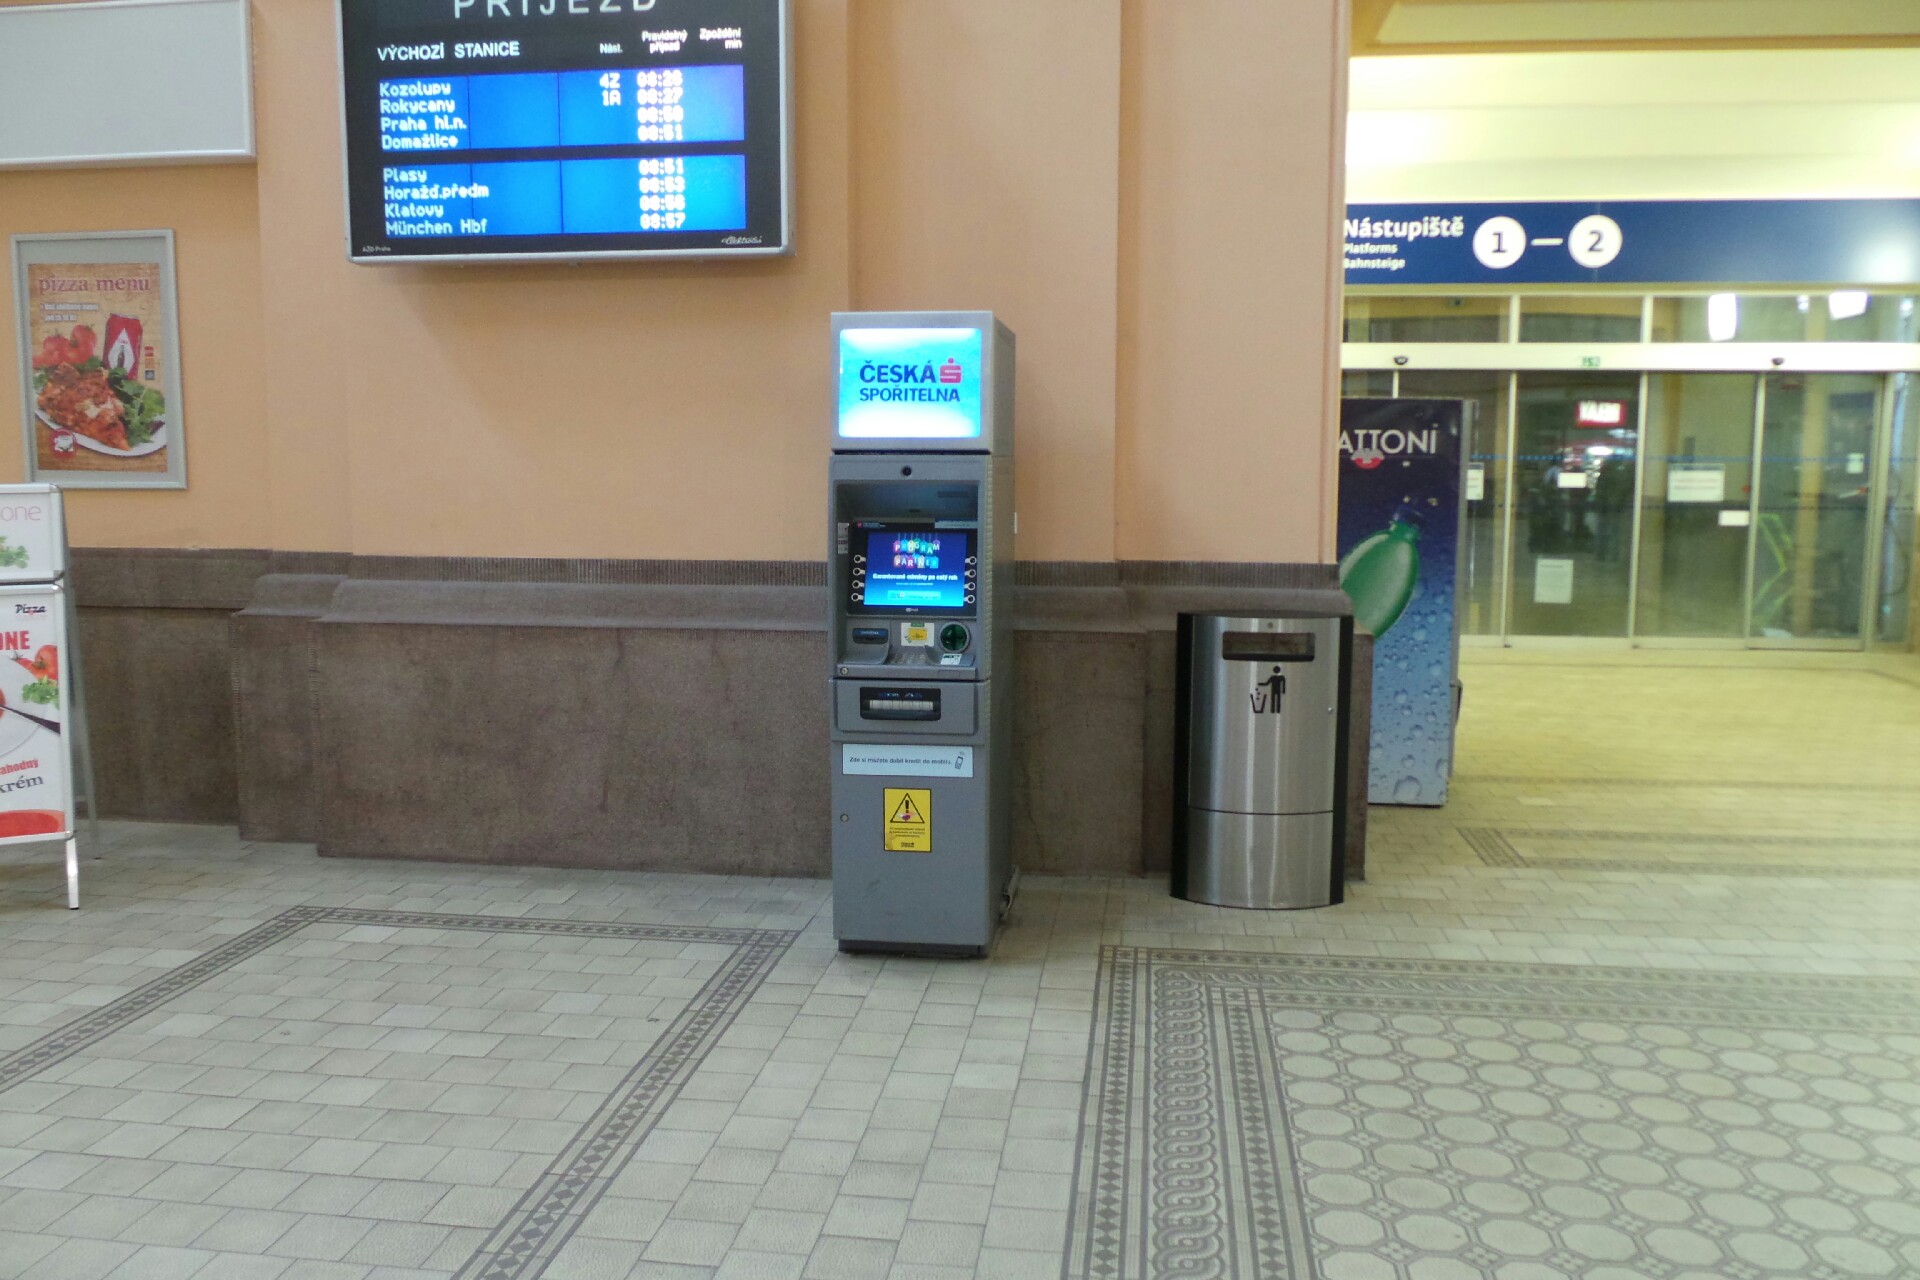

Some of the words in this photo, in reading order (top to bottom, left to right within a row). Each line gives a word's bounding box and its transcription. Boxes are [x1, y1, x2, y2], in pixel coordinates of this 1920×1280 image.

[377, 42, 445, 61] VÝCHOZÍ
[454, 41, 520, 59] STANICE
[725, 39, 743, 49] min
[379, 82, 451, 97] Kozolupy
[380, 98, 455, 114] Rokycany
[602, 90, 621, 106] 1A
[381, 116, 427, 132] Praha
[381, 133, 458, 149] Domažlice
[383, 168, 427, 183] Plasy
[384, 203, 444, 218] Klatovy
[385, 219, 453, 236] München
[460, 218, 488, 234] Hbf
[1344, 216, 1464, 241] Nástupiště
[1492, 231, 1508, 253] 1
[1587, 229, 1605, 252] 2
[1344, 242, 1399, 254] Platforms
[1343, 257, 1406, 271] Bahnsteige
[39, 275, 89, 296] pizza
[96, 276, 152, 292] menu
[859, 360, 937, 383] ČESKÁ
[859, 385, 961, 402] SPOŘITELNA
[894, 541, 940, 555] PROGRAM
[895, 556, 938, 566] PARTNER
[15, 603, 47, 614] Pizza
[0, 630, 30, 651] NE
